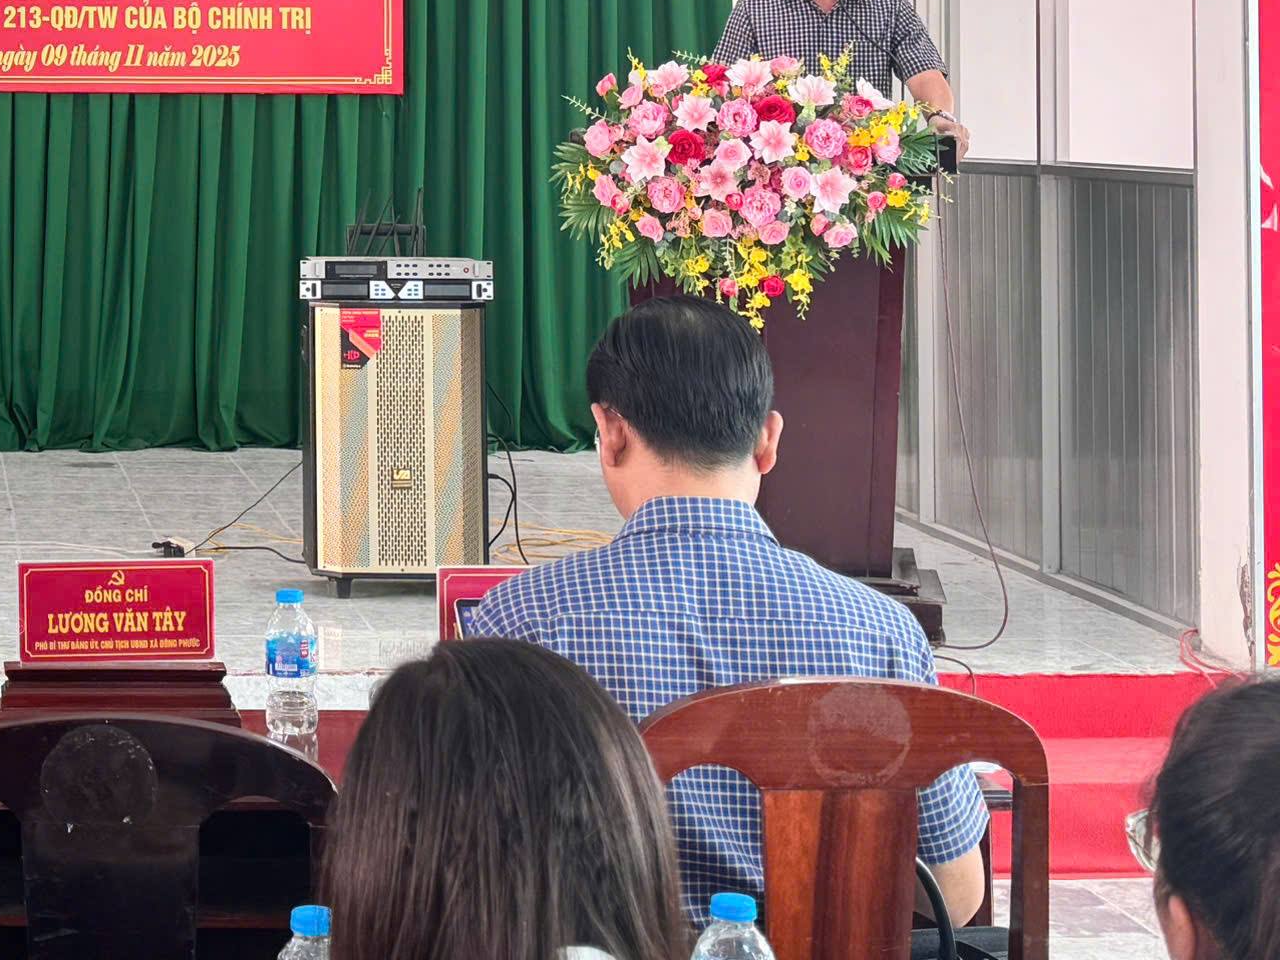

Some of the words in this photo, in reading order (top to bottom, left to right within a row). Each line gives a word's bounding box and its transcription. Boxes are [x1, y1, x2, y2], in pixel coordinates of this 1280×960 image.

[3, 5, 119, 32] 213-QĐ/TW
[173, 1, 202, 35] BỘ
[208, 1, 273, 30] CHÍNH
[278, 6, 312, 35] TRỊ
[41, 43, 68, 67] 09
[70, 44, 122, 73] tháng
[124, 44, 145, 67] 11
[147, 45, 187, 67] năm
[189, 44, 241, 68] 2025
[84, 585, 122, 604] ĐỒNG
[124, 585, 148, 603] CHÍ
[47, 611, 110, 634] LƯƠNG
[112, 607, 149, 633] VĂN
[152, 606, 187, 632] TÂY
